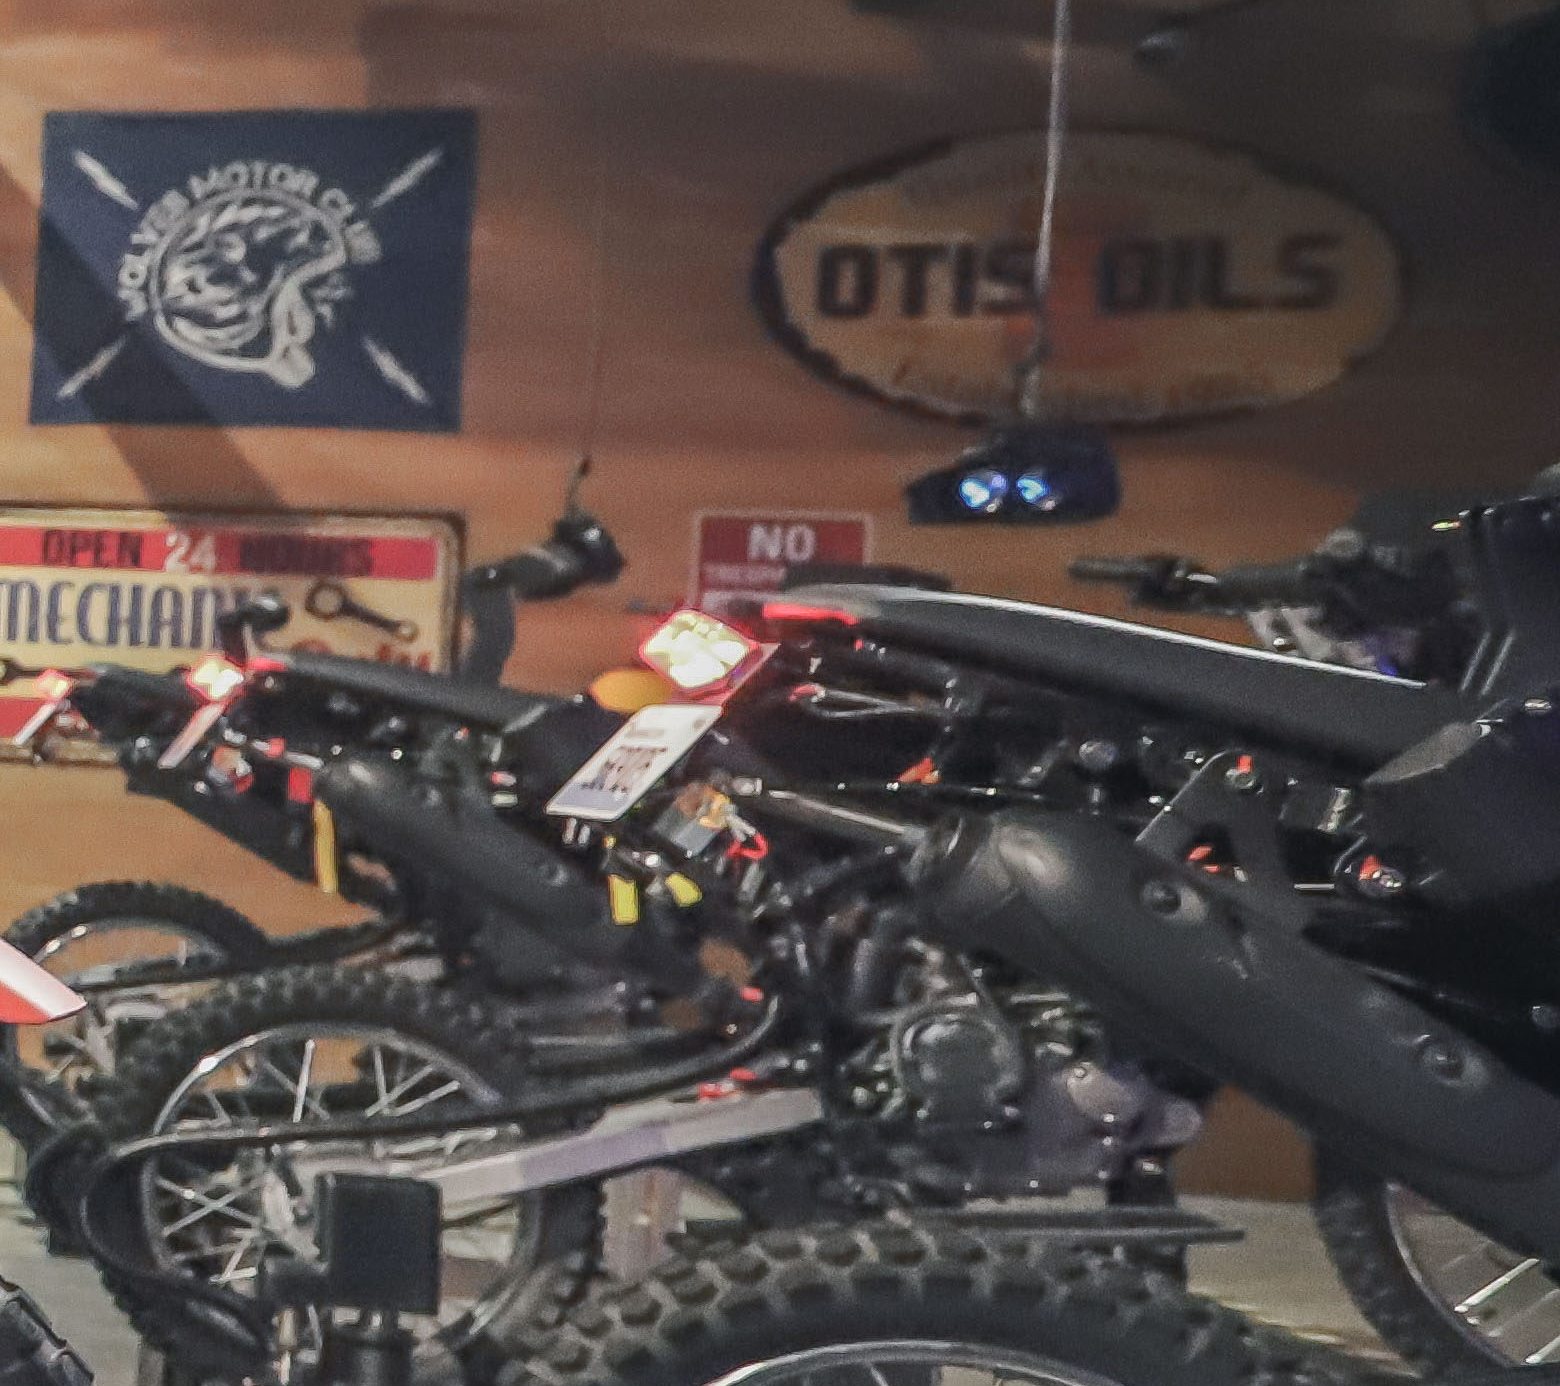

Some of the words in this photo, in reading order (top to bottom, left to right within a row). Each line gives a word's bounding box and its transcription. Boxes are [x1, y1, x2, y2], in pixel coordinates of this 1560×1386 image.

[188, 160, 320, 198] MOTOR
[815, 242, 1038, 319] OTIS
[1093, 233, 1345, 313] OILS
[42, 528, 142, 569] OPEN
[163, 531, 216, 573] 24
[747, 524, 817, 563] NO
